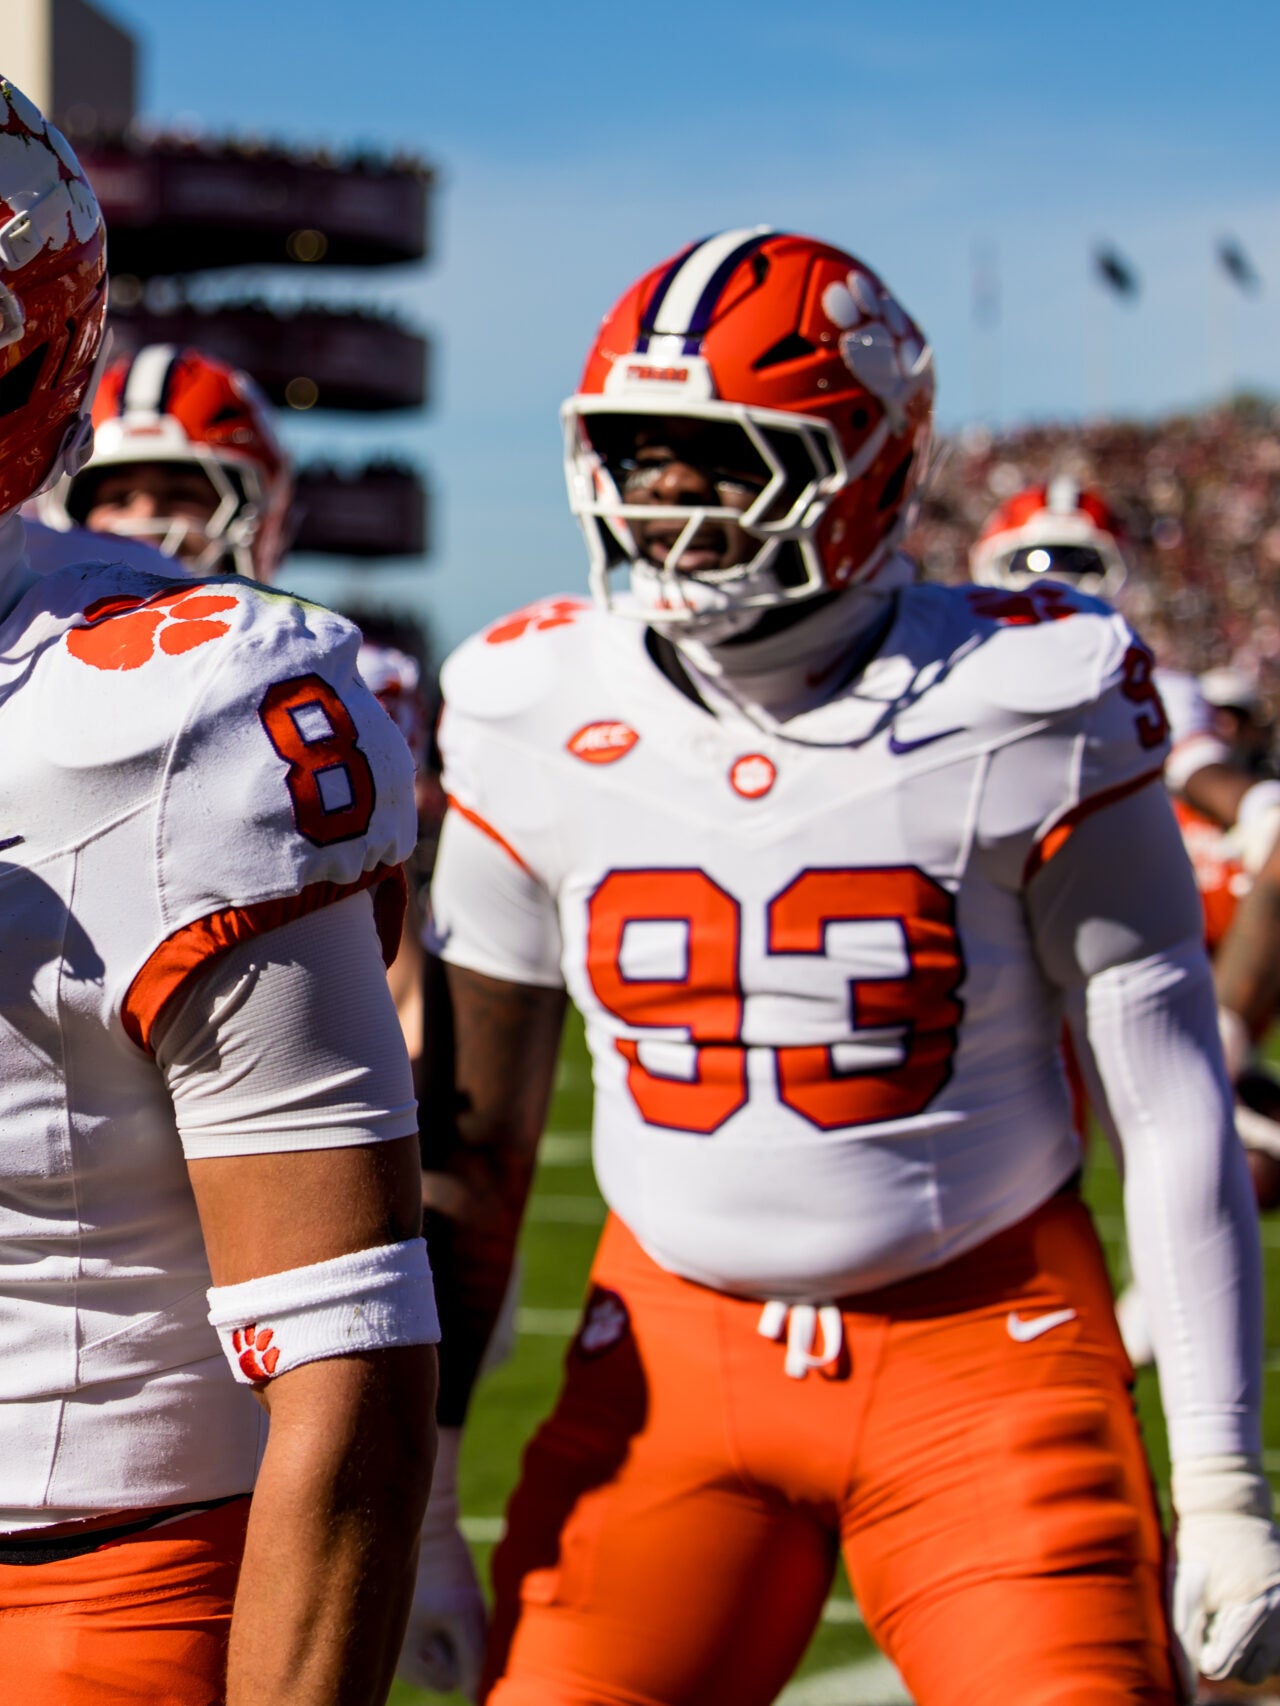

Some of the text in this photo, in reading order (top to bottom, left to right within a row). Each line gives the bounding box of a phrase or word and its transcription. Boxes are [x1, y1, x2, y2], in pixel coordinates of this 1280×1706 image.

[257, 672, 376, 848] 8
[572, 725, 631, 754] ACC
[586, 865, 966, 1135] 93
